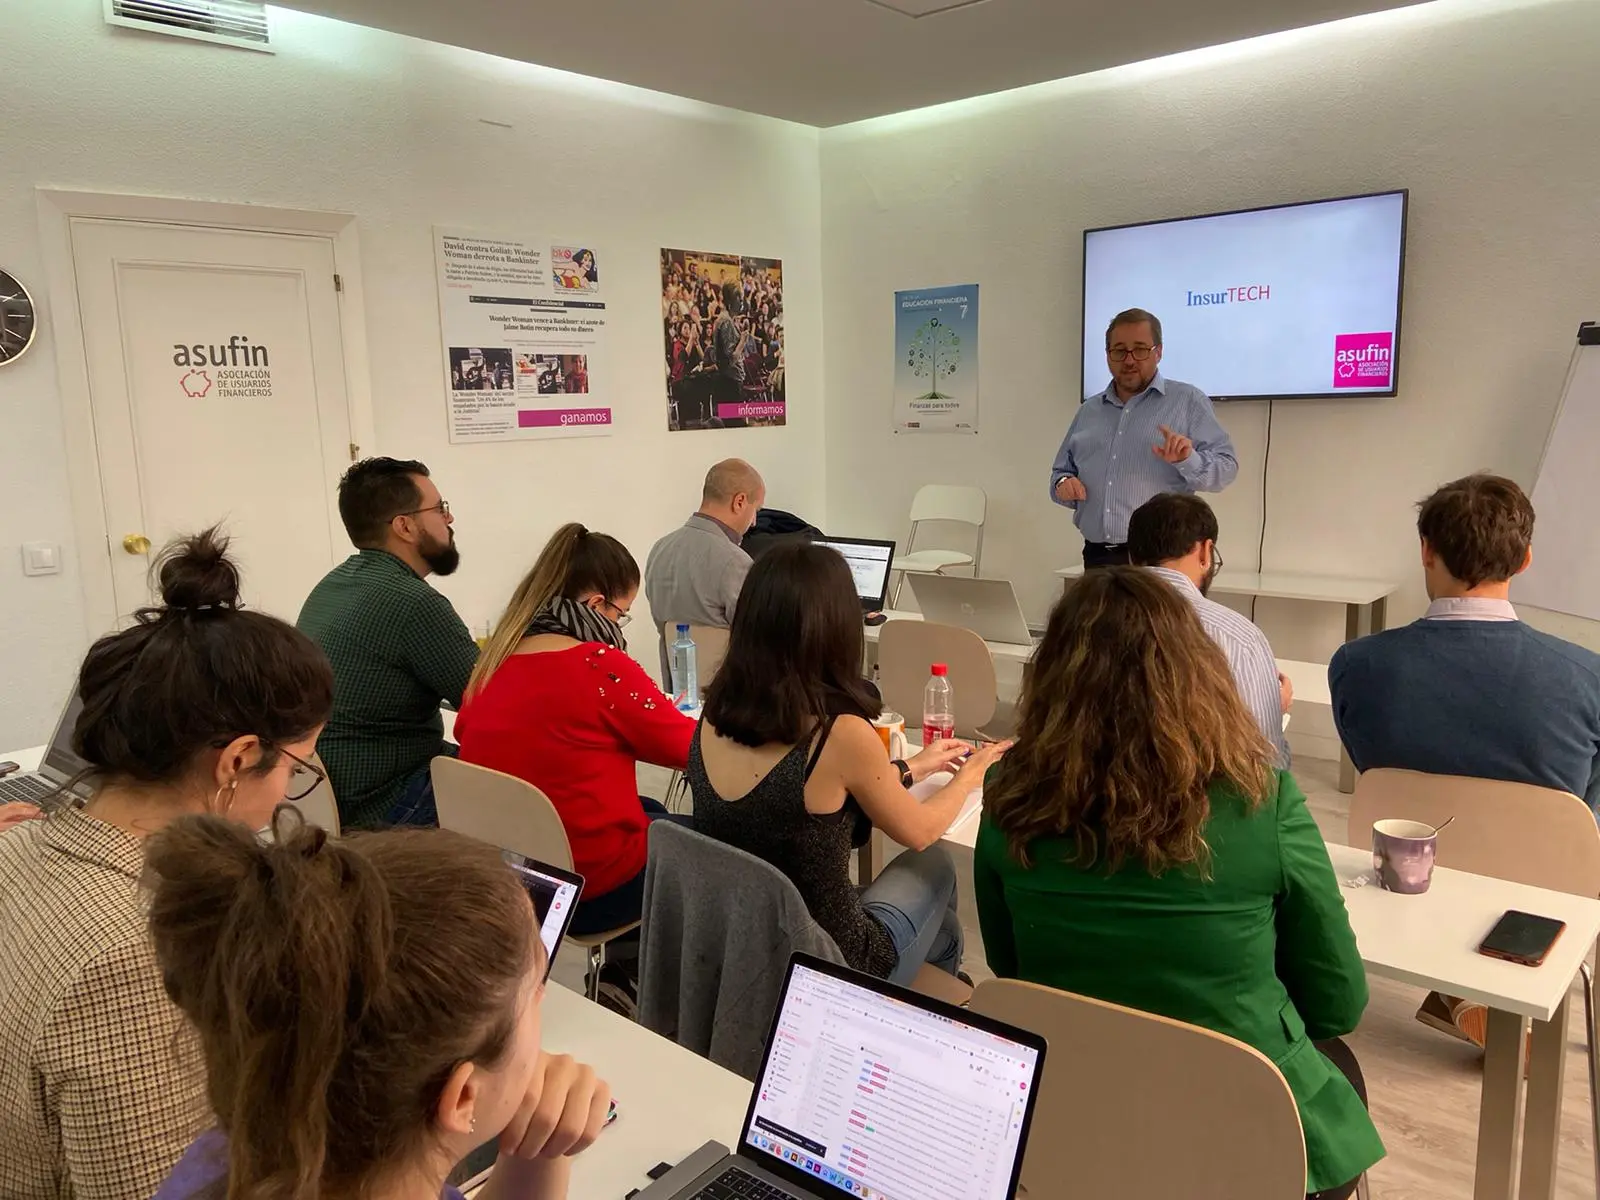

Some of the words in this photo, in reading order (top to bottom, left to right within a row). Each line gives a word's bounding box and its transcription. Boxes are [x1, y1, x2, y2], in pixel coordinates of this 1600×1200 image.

[444, 242, 465, 251] David
[490, 246, 513, 255] Goliat:
[514, 248, 540, 257] Wonder
[444, 250, 472, 259] Woman
[473, 253, 499, 262] derrota
[506, 256, 540, 265] Bankinter
[1187, 285, 1270, 307] InsurTECH
[173, 335, 268, 366] asufin
[1337, 344, 1389, 362] asufin
[218, 368, 271, 379] ASOCIACIÓN
[231, 380, 271, 388] USUARIOS
[219, 389, 272, 397] FINANCIEROS
[738, 404, 783, 415] informamos
[560, 411, 607, 426] ganamos
